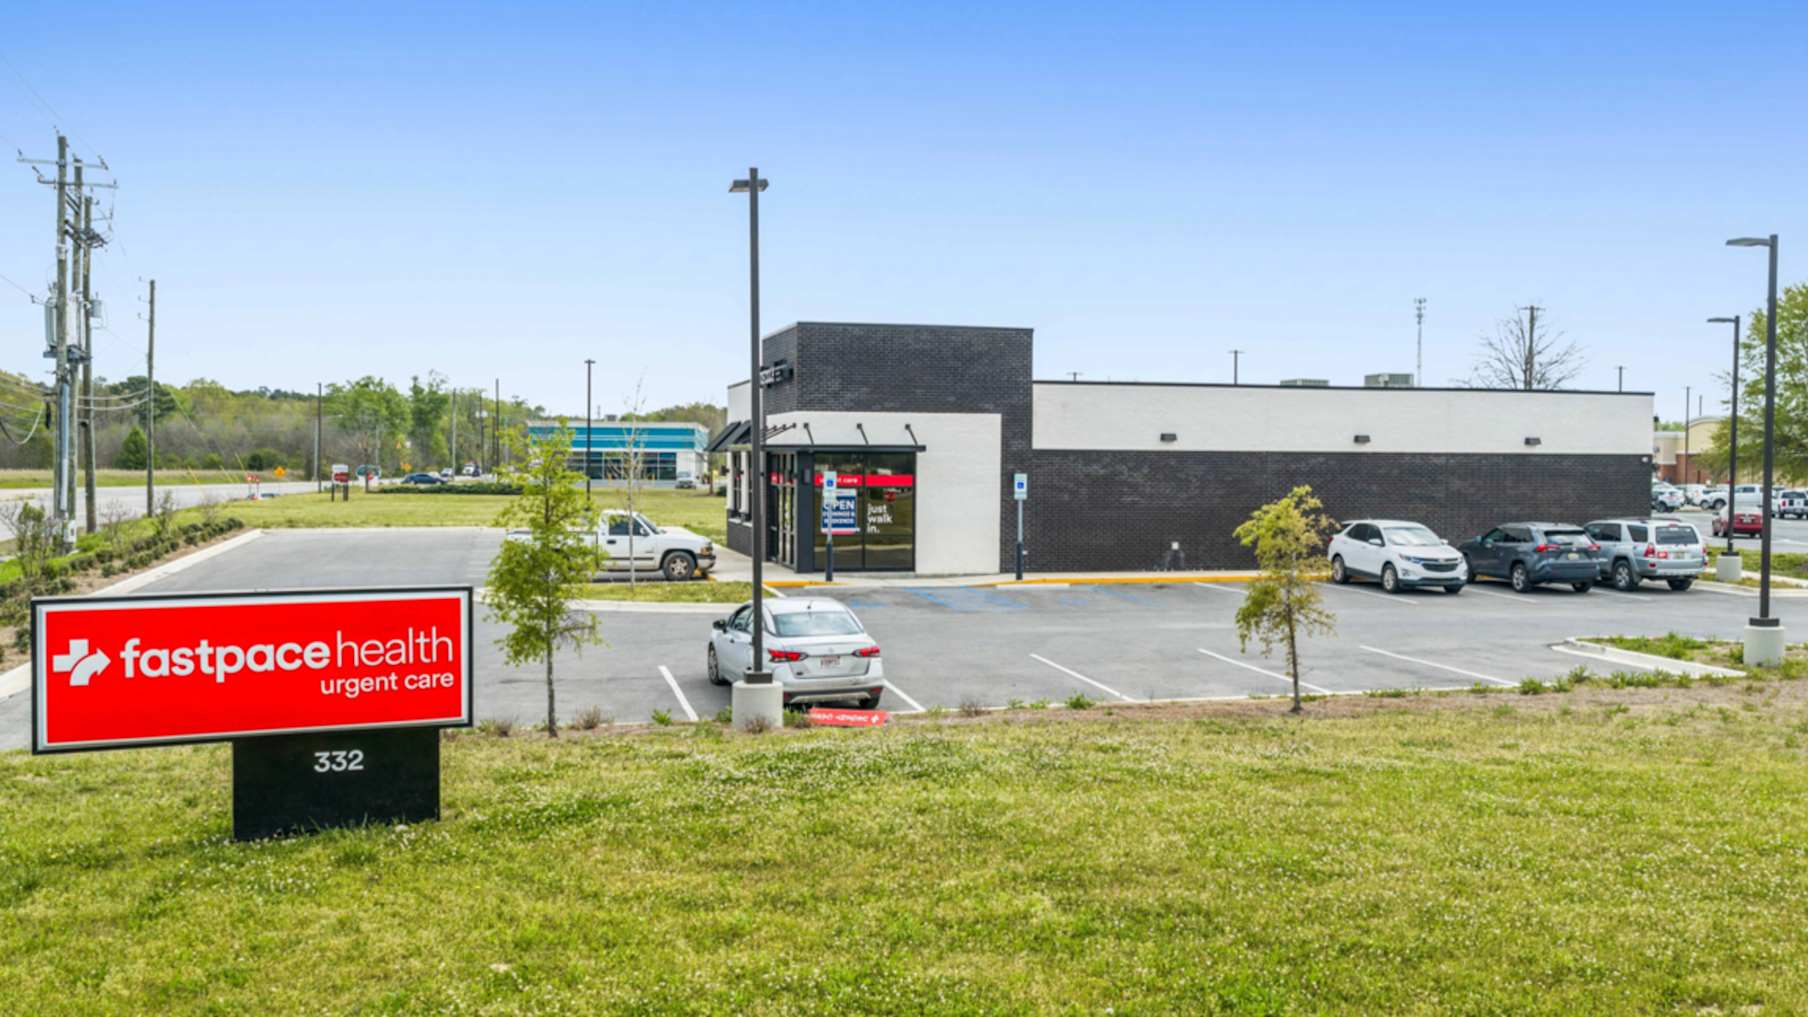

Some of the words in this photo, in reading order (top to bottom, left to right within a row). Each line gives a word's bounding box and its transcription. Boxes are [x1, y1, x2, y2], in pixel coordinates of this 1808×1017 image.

[867, 503, 887, 516] just
[867, 512, 893, 524] walk
[866, 524, 881, 534] in.
[120, 637, 332, 684] fastpace
[336, 626, 453, 668] health
[320, 672, 398, 698] urgent
[404, 672, 454, 690] care
[313, 749, 364, 773] 332
